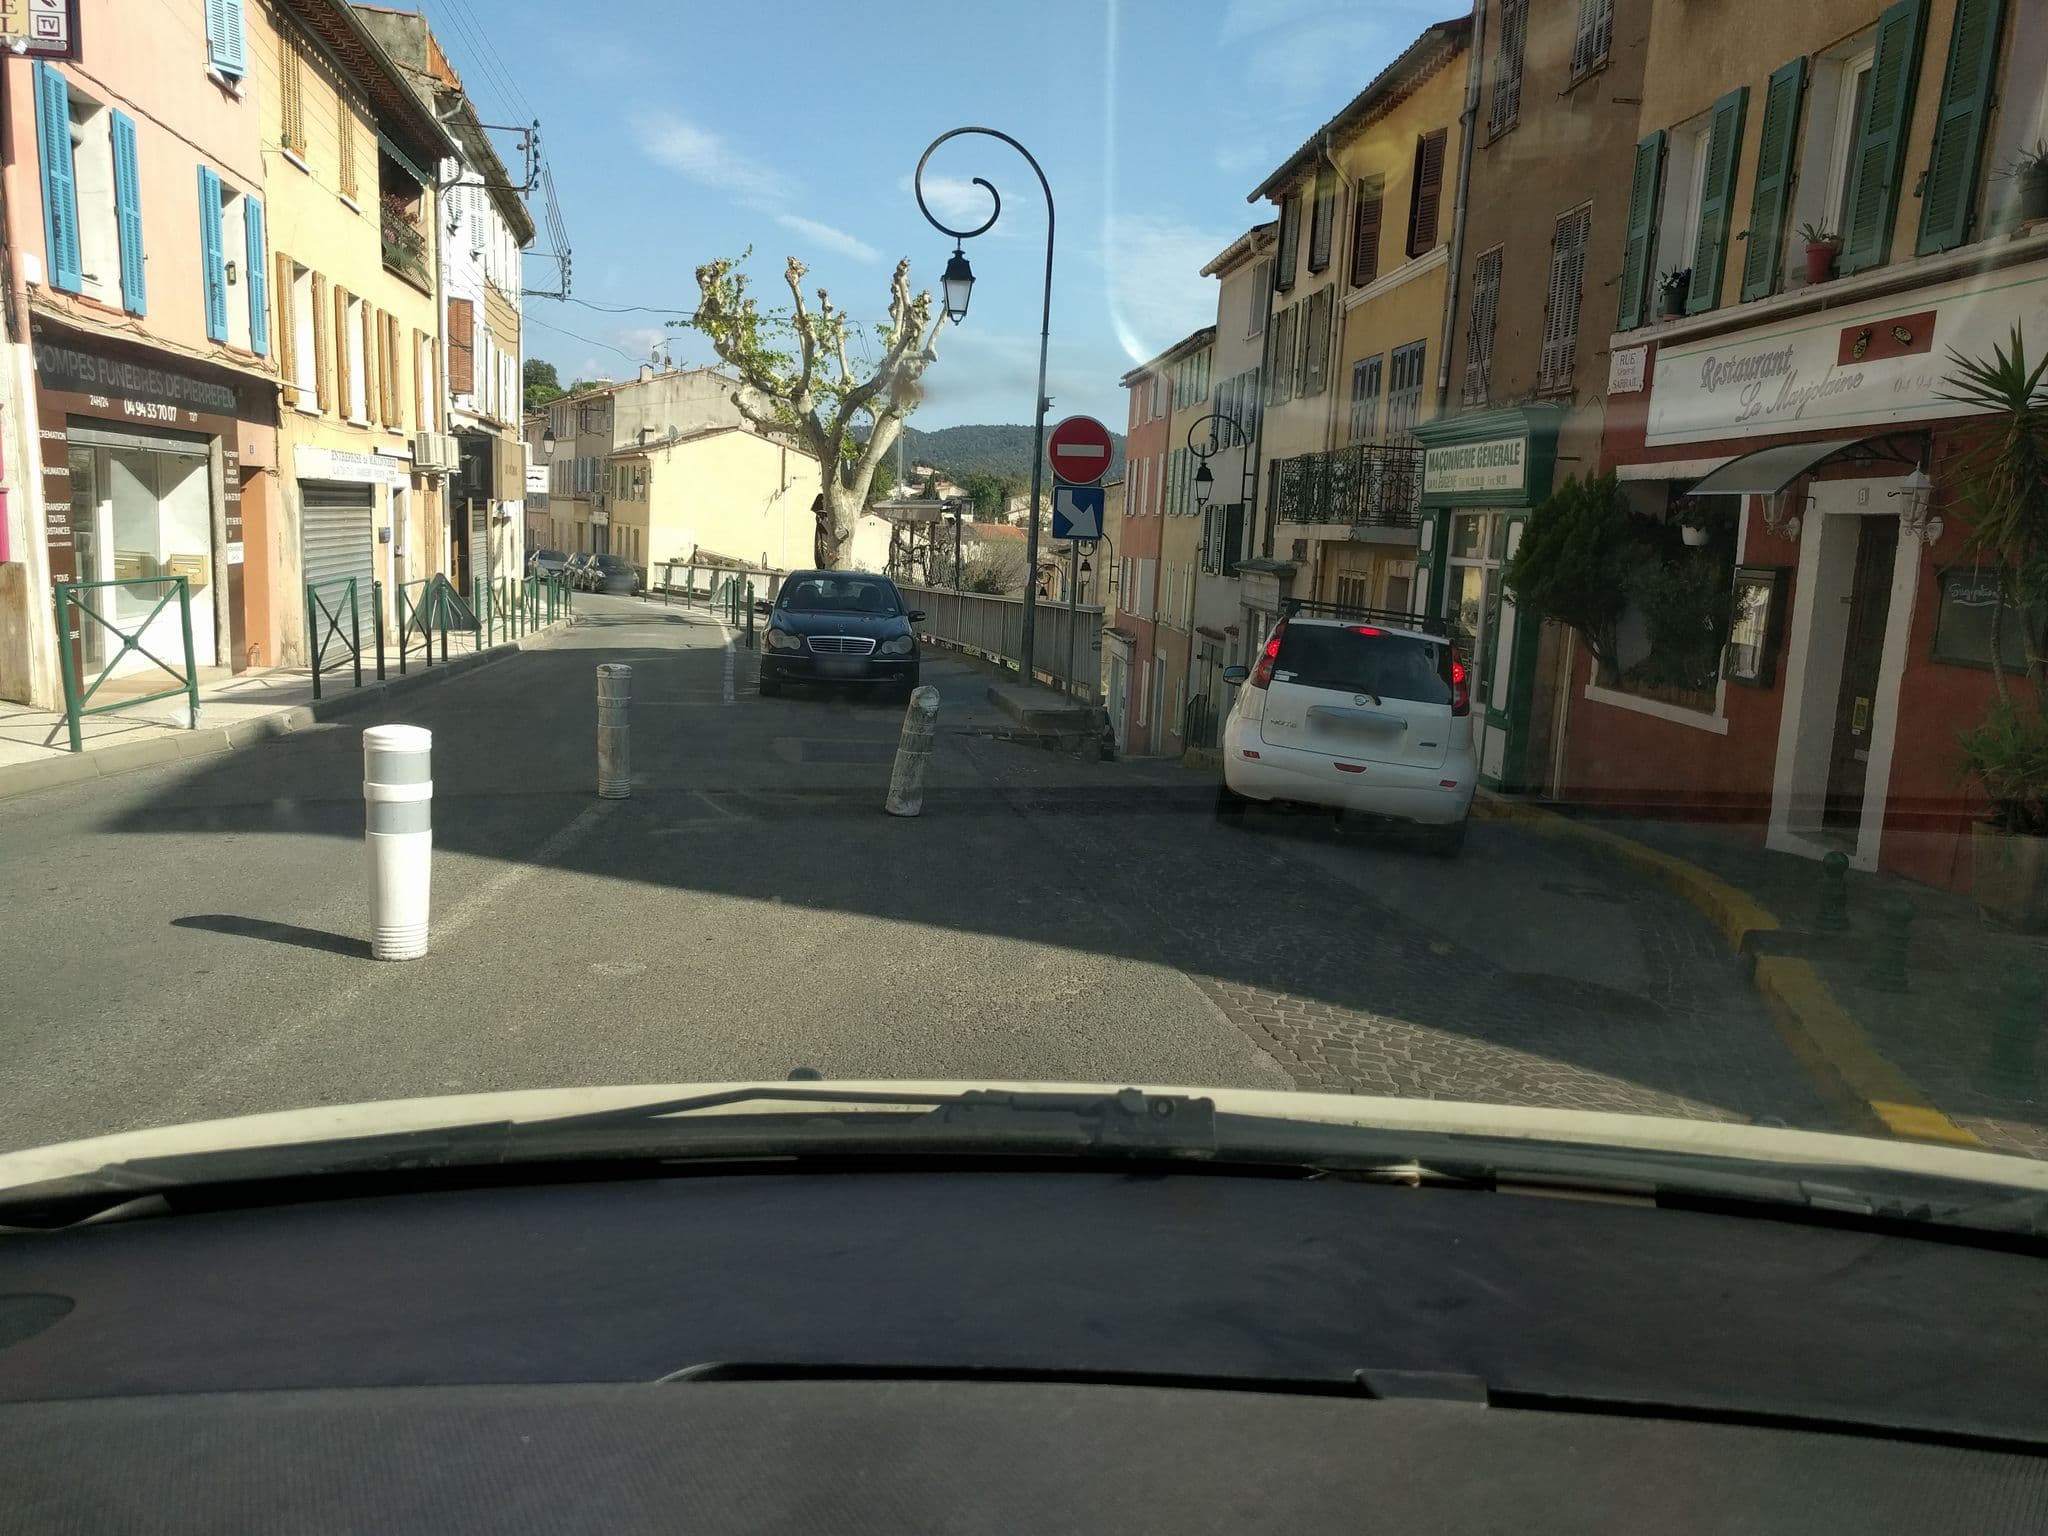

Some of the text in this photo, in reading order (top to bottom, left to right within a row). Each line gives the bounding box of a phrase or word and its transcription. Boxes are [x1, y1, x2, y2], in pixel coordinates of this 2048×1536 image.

[41, 20, 55, 30] TV
[33, 343, 96, 382] POMPES
[166, 373, 181, 399] DE
[1620, 352, 1637, 366] RUE
[1700, 344, 1793, 393] Restaurant
[124, 399, 135, 415] 04
[135, 402, 146, 417] 94
[147, 403, 157, 418] 33
[1766, 364, 1864, 421] Marjolaine
